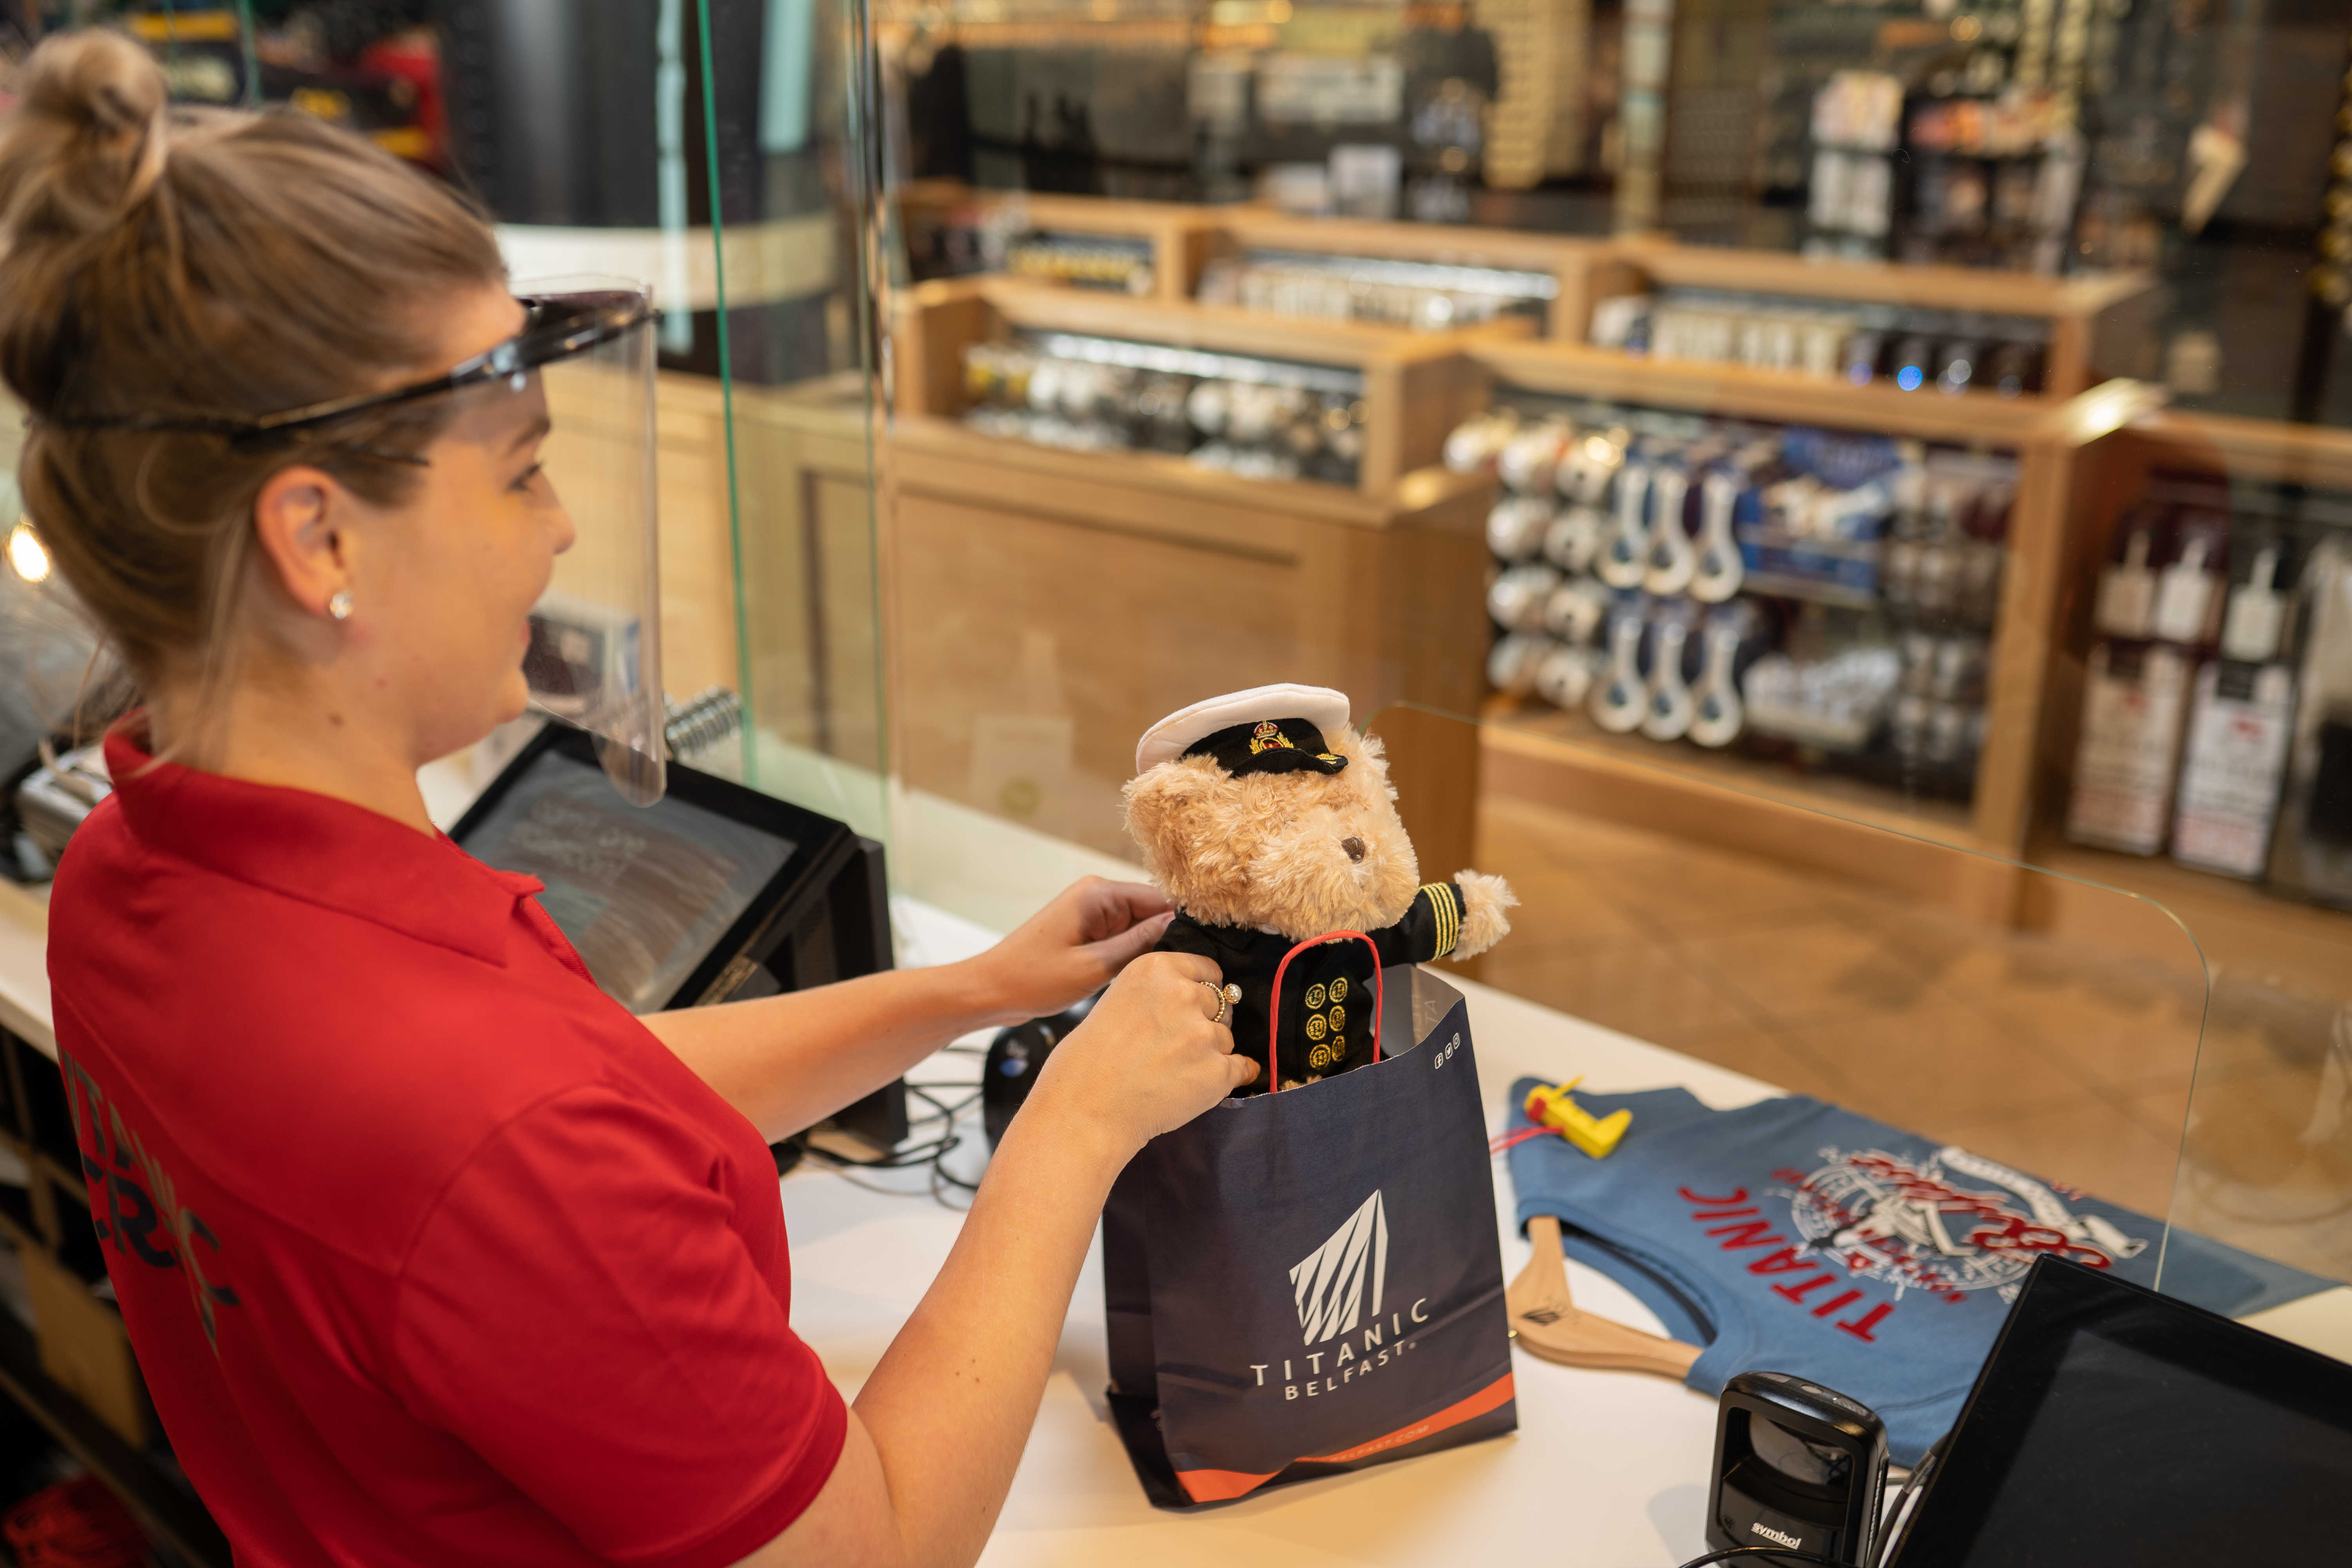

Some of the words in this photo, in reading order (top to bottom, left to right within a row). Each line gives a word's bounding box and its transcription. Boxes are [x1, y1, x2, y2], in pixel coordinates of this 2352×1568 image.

[56, 1041, 241, 1307] ITANIC
[1677, 1184, 1896, 1344] TITANIC
[1250, 1298, 1429, 1386] TITANIC
[1751, 1522, 1802, 1548] symbol
